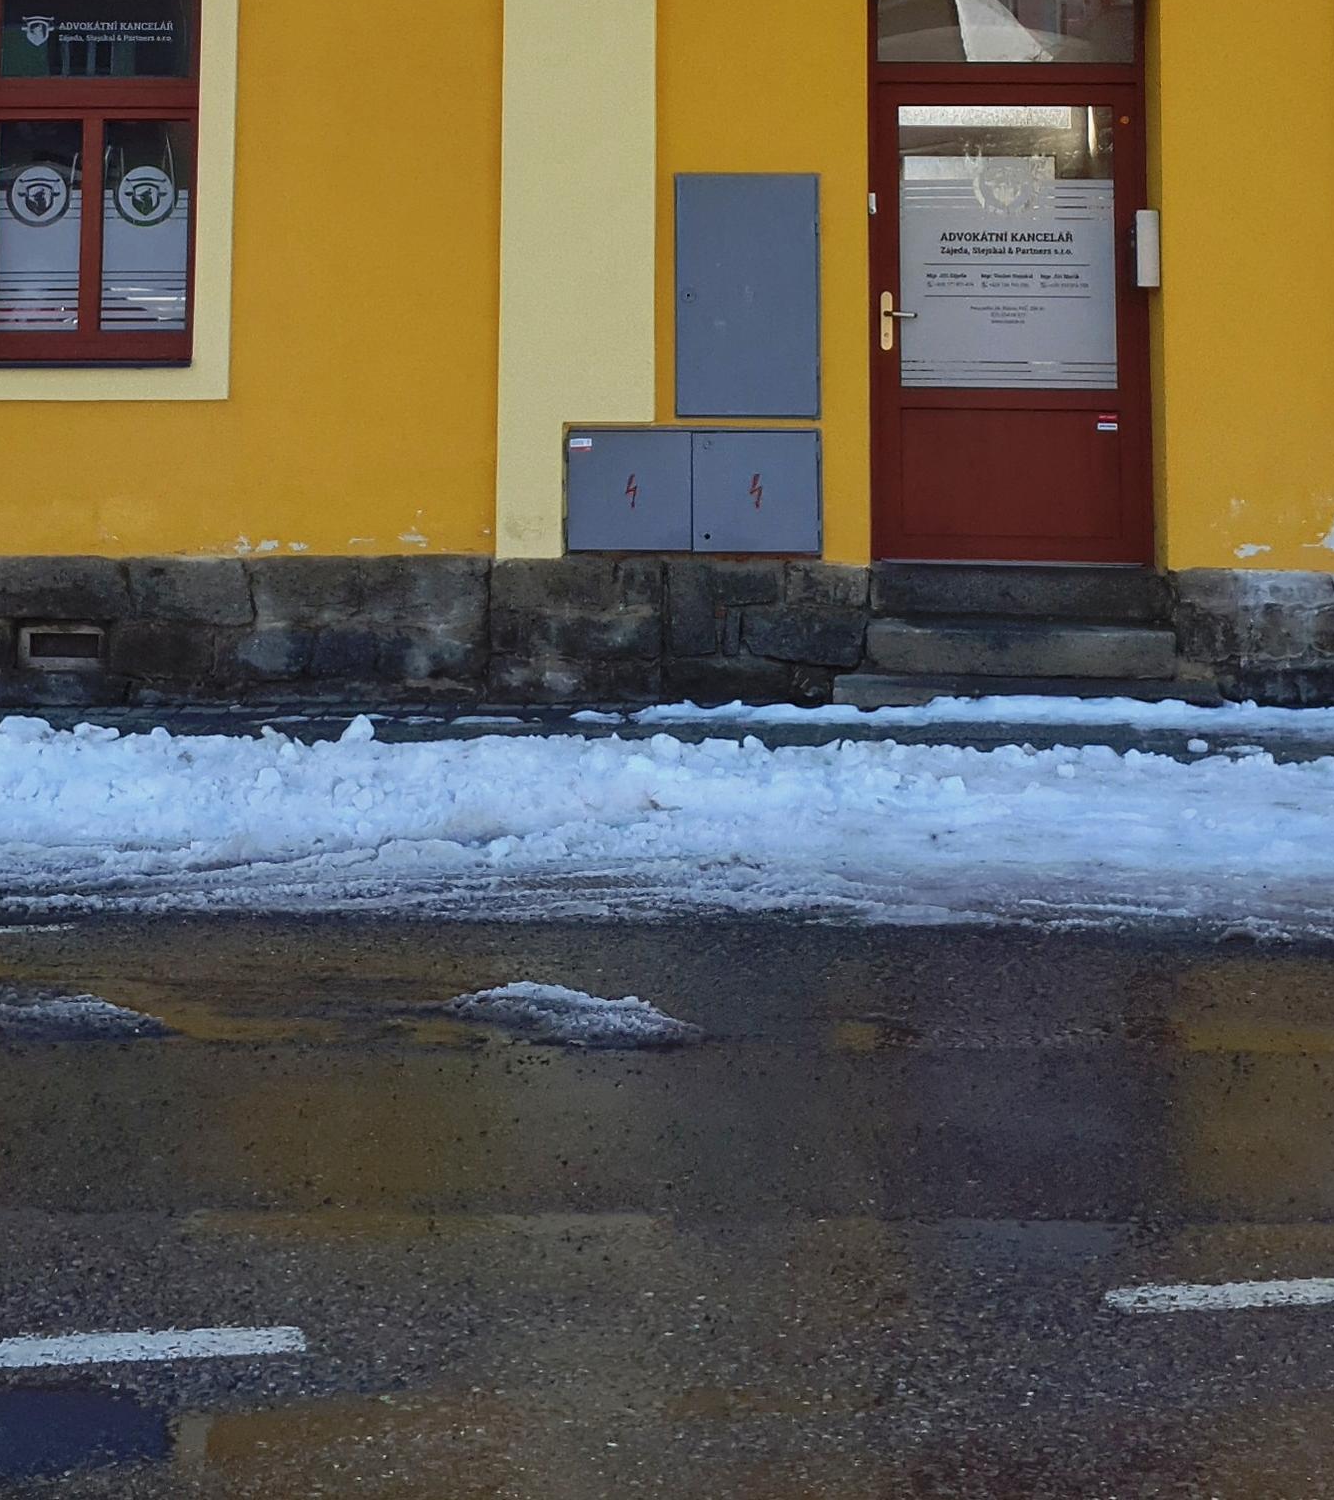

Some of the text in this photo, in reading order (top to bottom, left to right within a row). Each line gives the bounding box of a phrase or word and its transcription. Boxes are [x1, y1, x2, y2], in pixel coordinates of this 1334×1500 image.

[58, 21, 174, 31] ADVOKÁTNÍ KANCELÁŘ
[940, 231, 1073, 242] ADVOKÁTNÍ KANCELÁŘ
[1008, 247, 1014, 255] &
[1016, 246, 1052, 255] Partners
